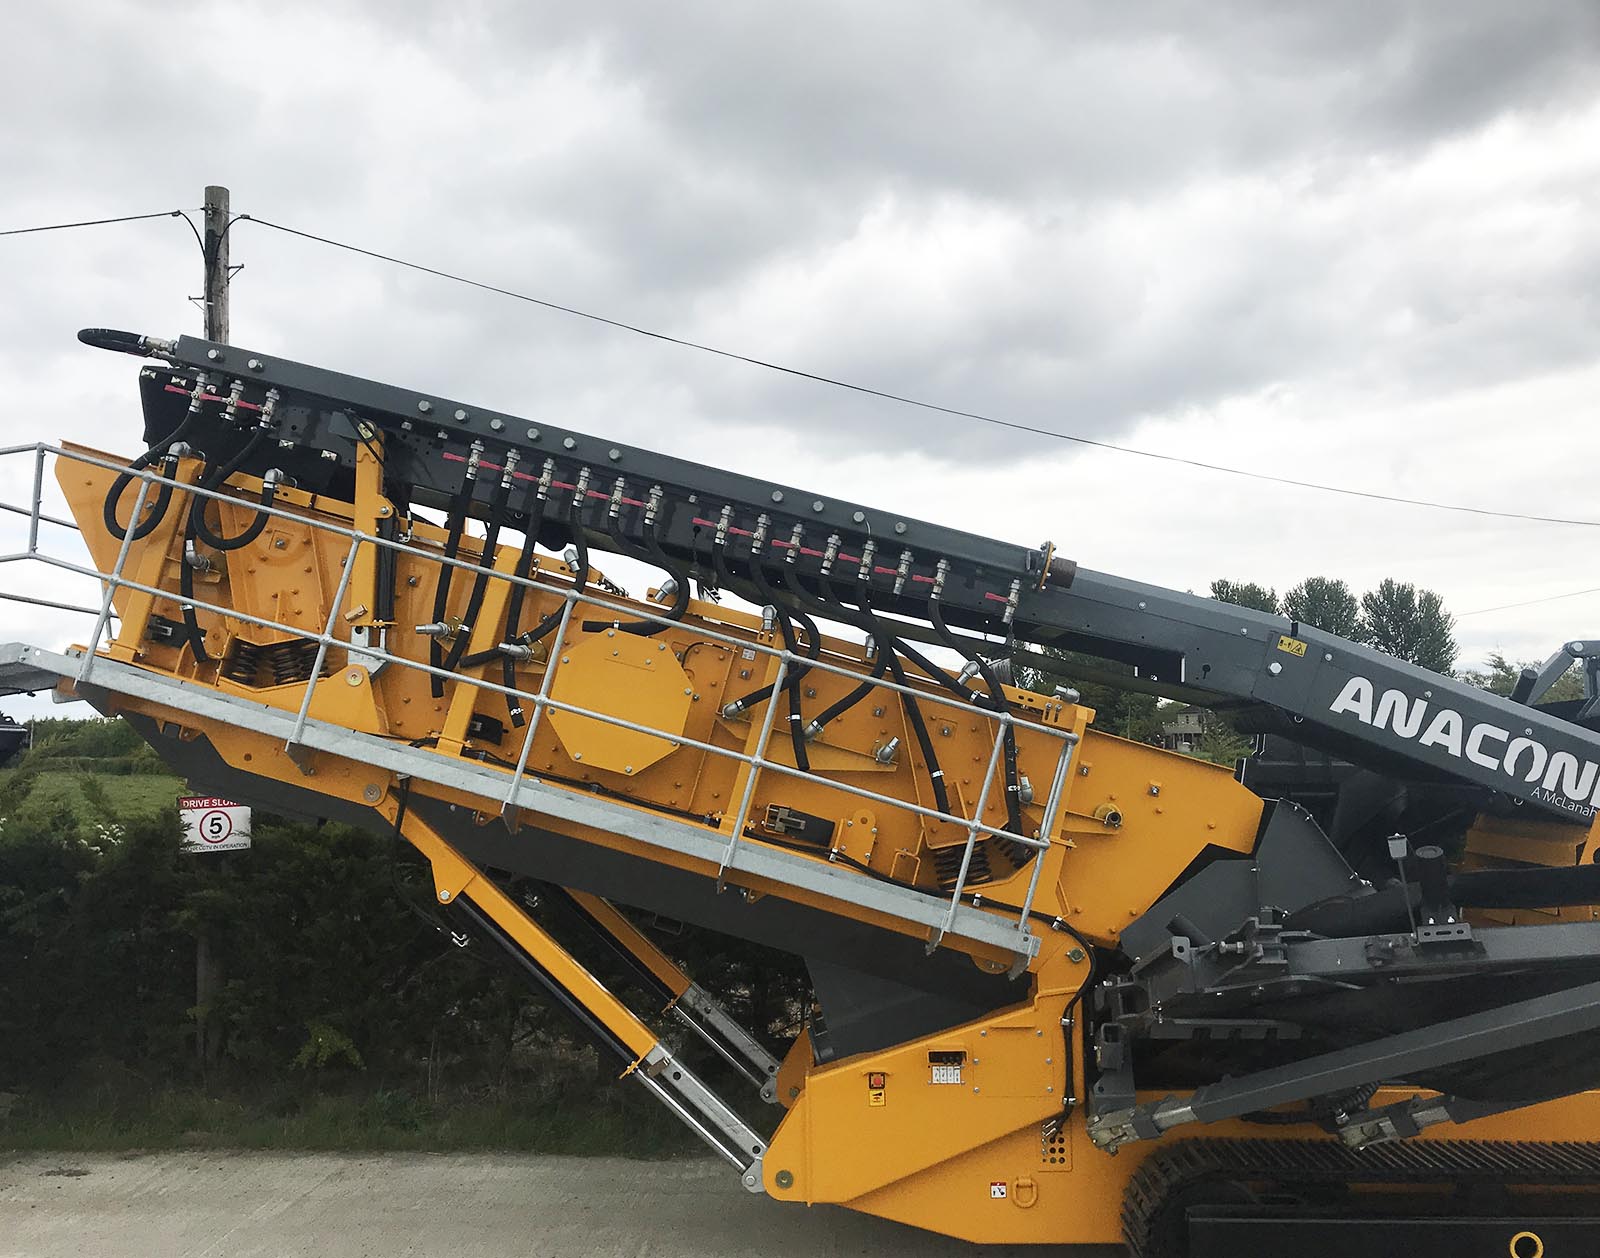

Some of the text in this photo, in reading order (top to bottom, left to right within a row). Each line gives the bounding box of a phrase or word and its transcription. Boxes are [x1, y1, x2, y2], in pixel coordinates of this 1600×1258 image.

[1328, 676, 1600, 808] ANACON
[1530, 786, 1540, 798] A
[211, 799, 237, 807] SLO
[209, 817, 222, 834] 5
